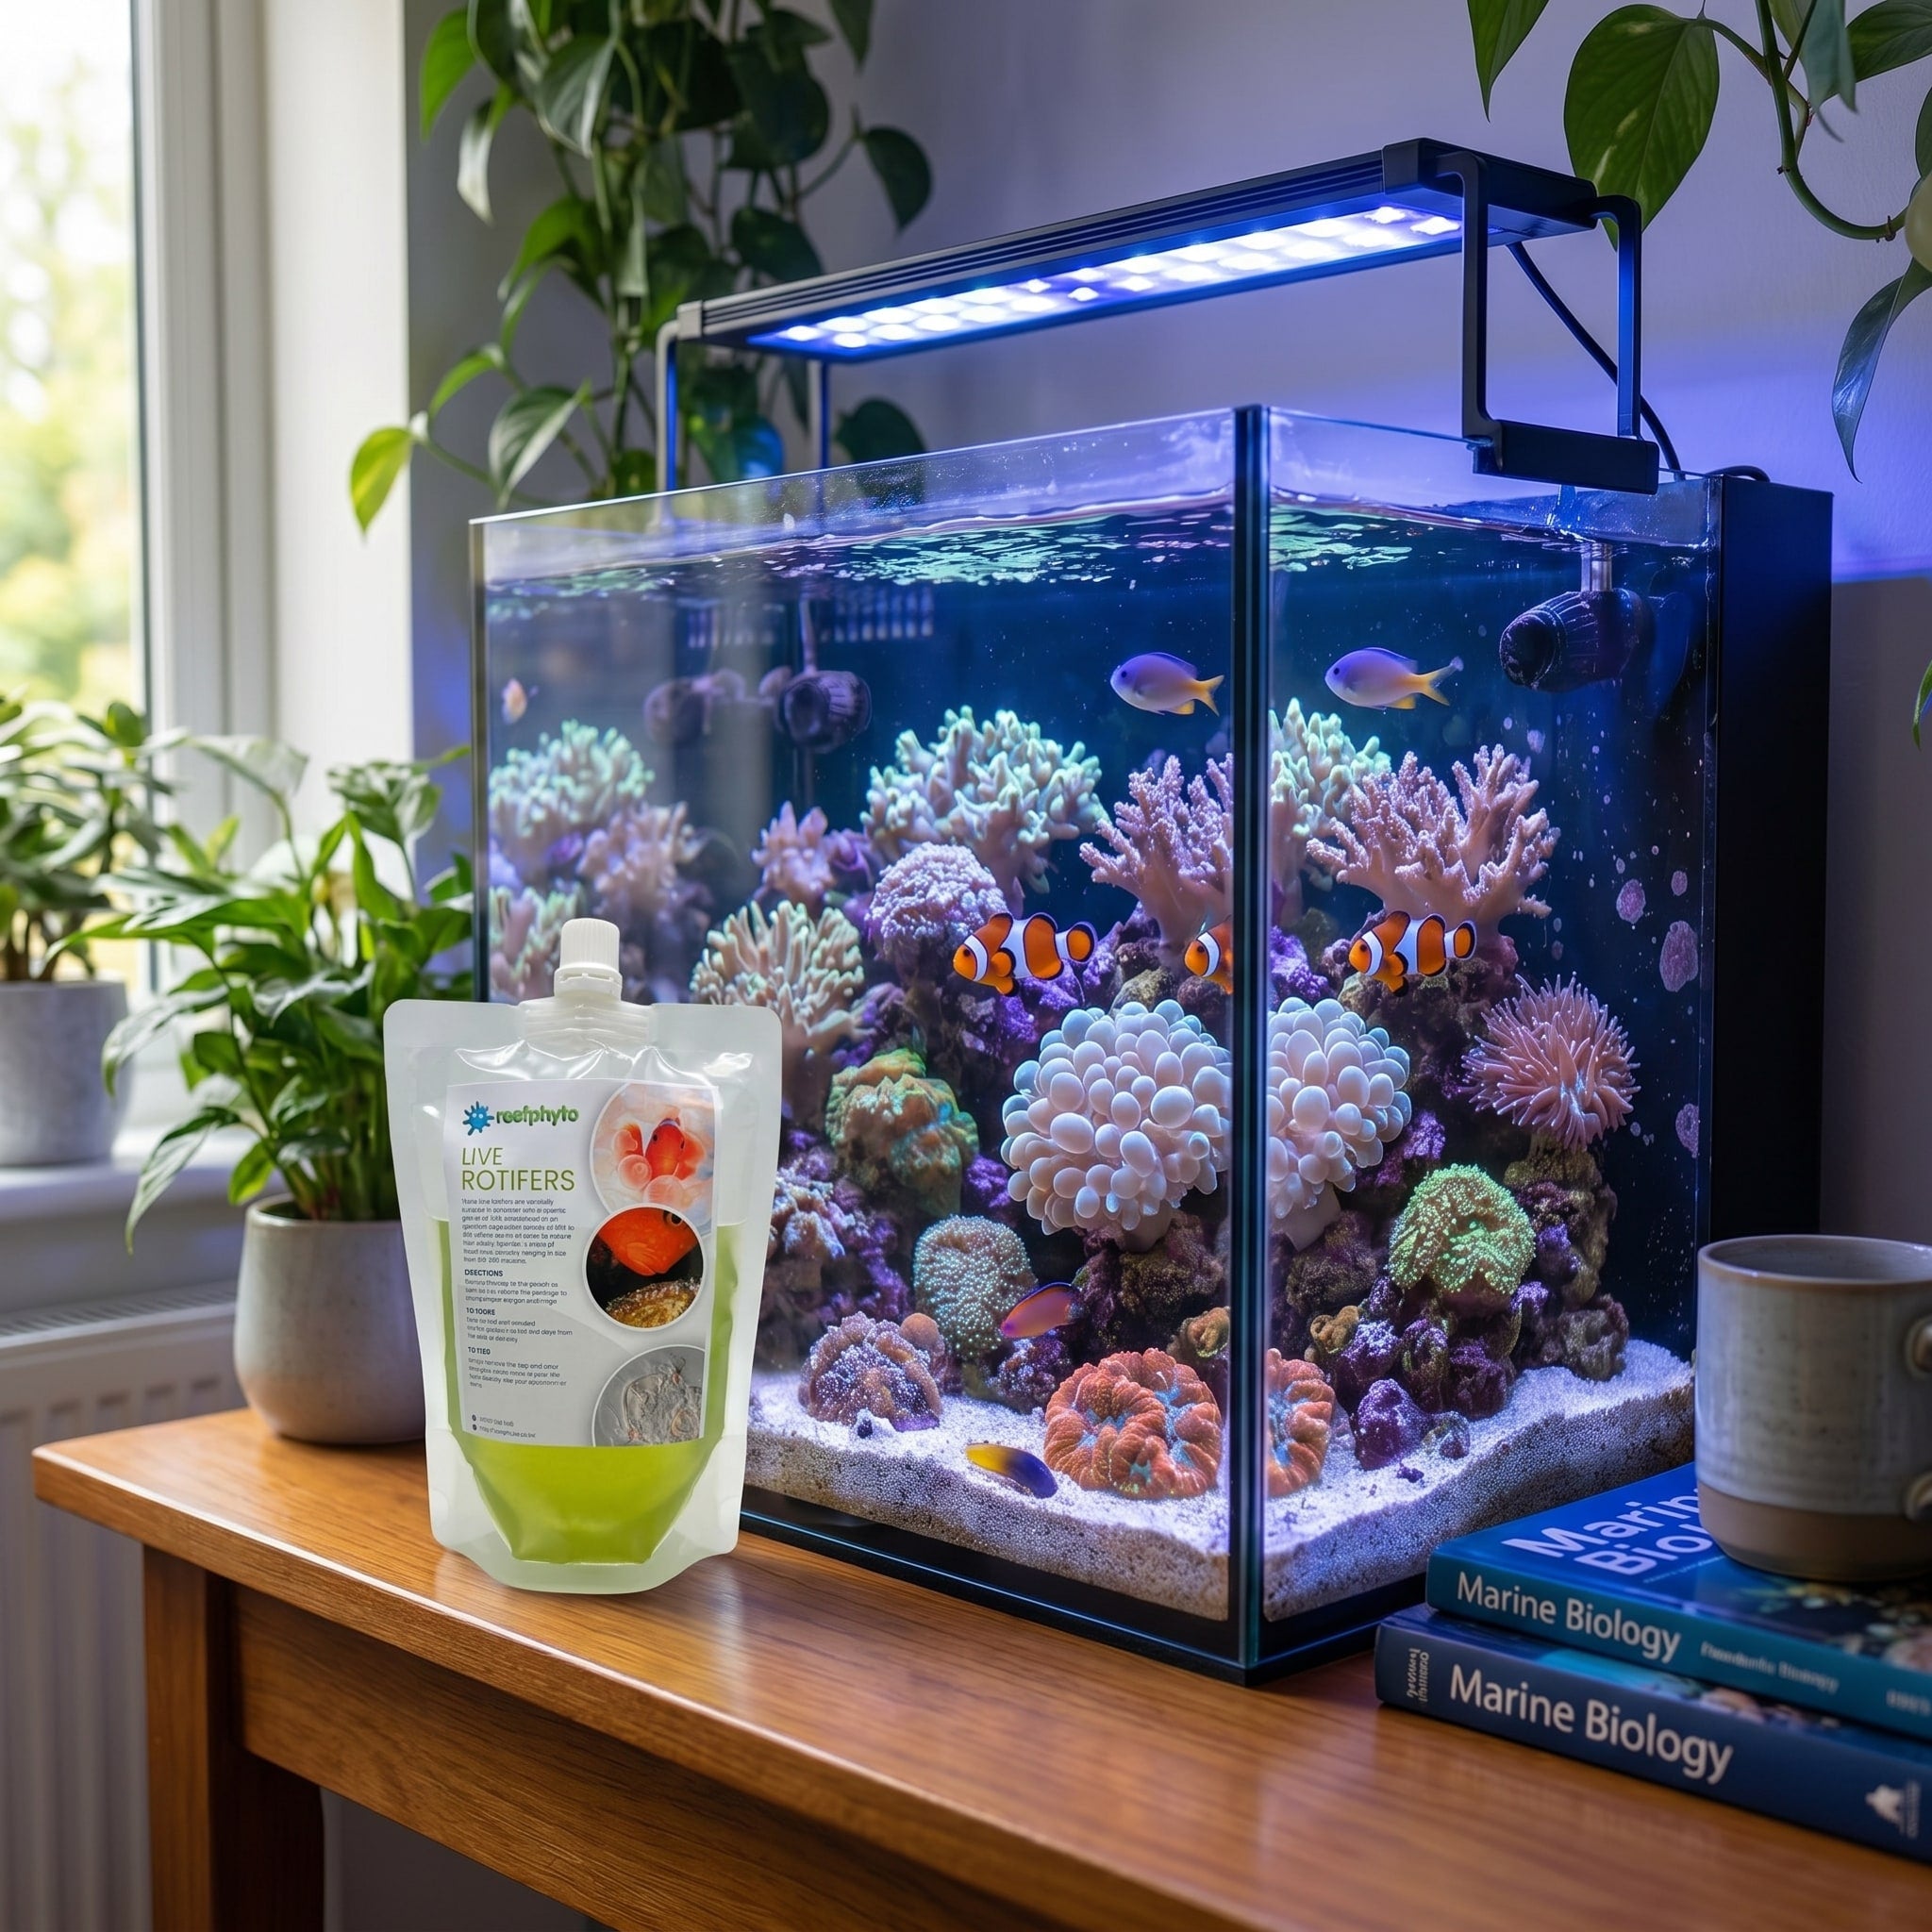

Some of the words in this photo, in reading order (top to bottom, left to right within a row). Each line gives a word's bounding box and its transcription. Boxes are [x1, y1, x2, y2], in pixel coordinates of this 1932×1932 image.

[496, 1105, 579, 1126] reefphyto
[462, 1147, 504, 1165] LIVE
[461, 1170, 575, 1191] ROTIFERS
[1501, 1488, 1699, 1557] Marin
[1457, 1571, 1557, 1625] Marine
[1565, 1597, 1682, 1665] Biology
[1449, 1663, 1574, 1734] Marine
[1585, 1699, 1734, 1786] Biology
